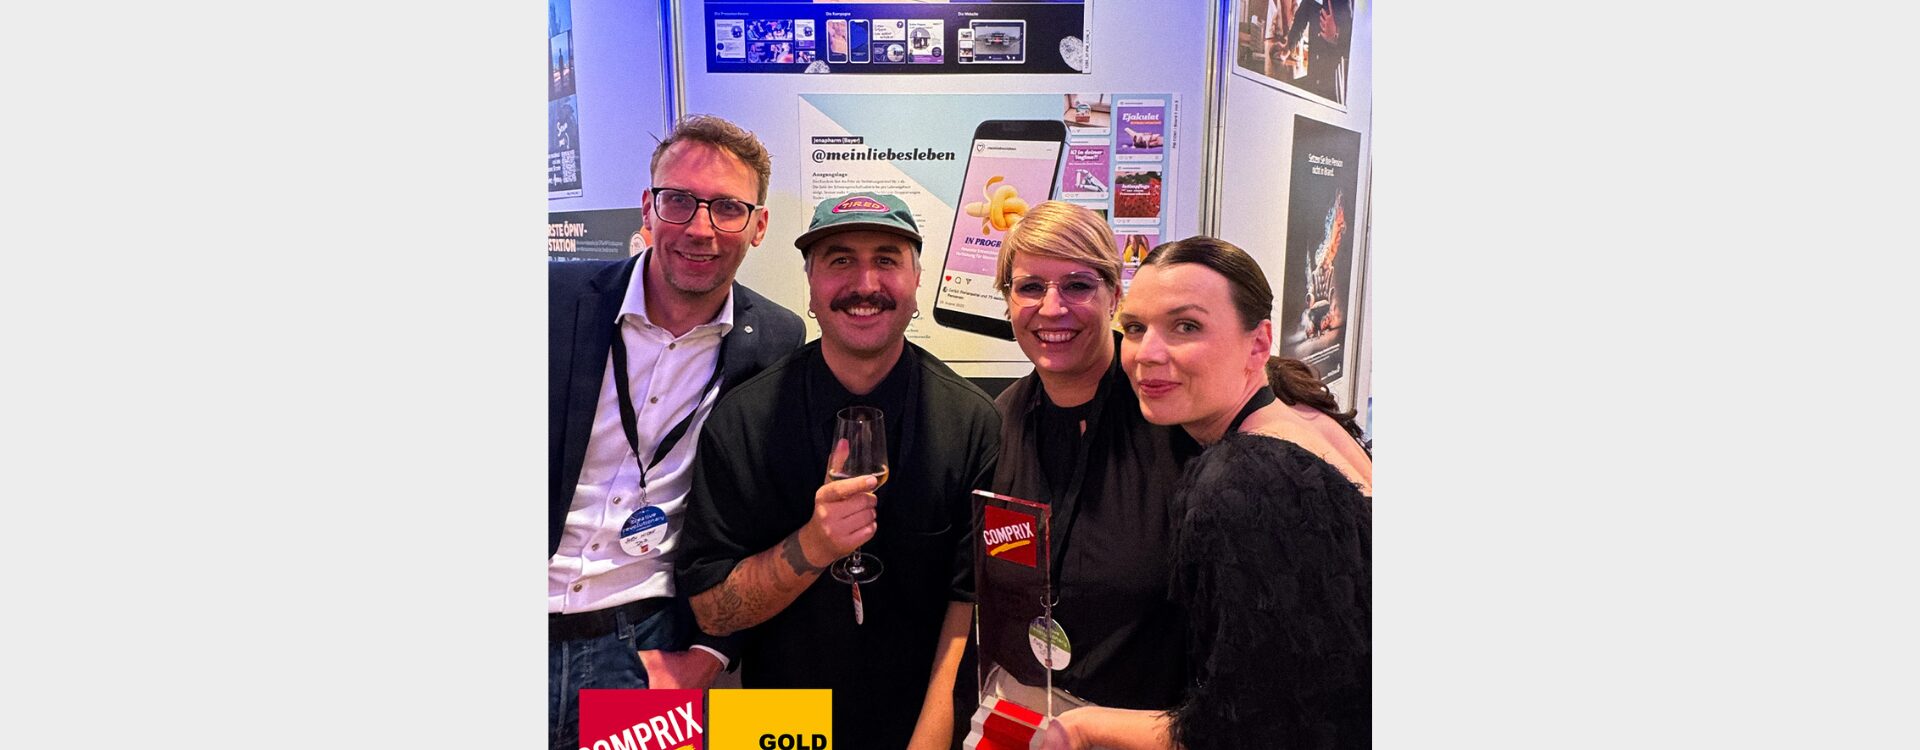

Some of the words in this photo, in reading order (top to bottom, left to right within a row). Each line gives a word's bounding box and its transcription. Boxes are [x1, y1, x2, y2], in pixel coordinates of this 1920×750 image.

[812, 148, 955, 163] @meinliebesleben
[842, 201, 880, 209] TIRED
[548, 238, 577, 253] STATION
[983, 522, 1034, 546] COMPRIX
